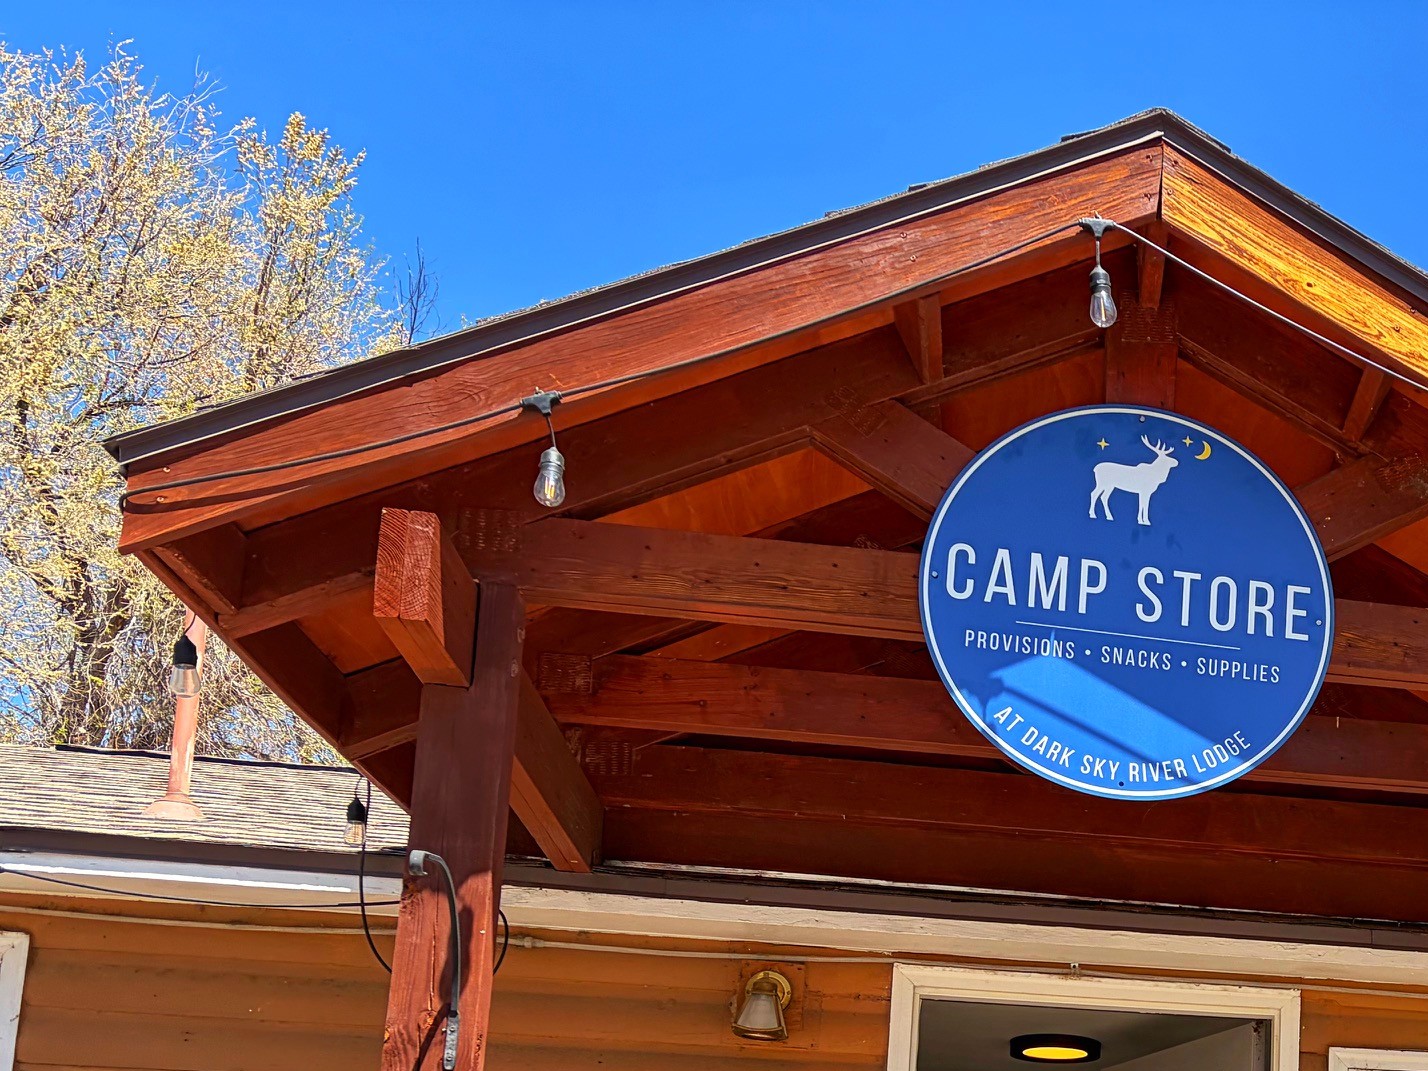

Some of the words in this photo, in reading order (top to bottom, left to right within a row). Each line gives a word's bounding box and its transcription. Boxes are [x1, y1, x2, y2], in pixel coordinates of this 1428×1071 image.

[946, 542, 1108, 615] CAMP
[1135, 566, 1312, 642] STORE
[965, 629, 1075, 660] PROVISIONS
[1101, 646, 1172, 671] SNACKS
[1196, 657, 1281, 683] SUPPLIES
[993, 706, 1025, 732] AT
[1021, 726, 1076, 768] DARK
[1080, 754, 1120, 781] SKY
[1129, 758, 1188, 782] RIVER
[1191, 730, 1251, 774] LODGE
